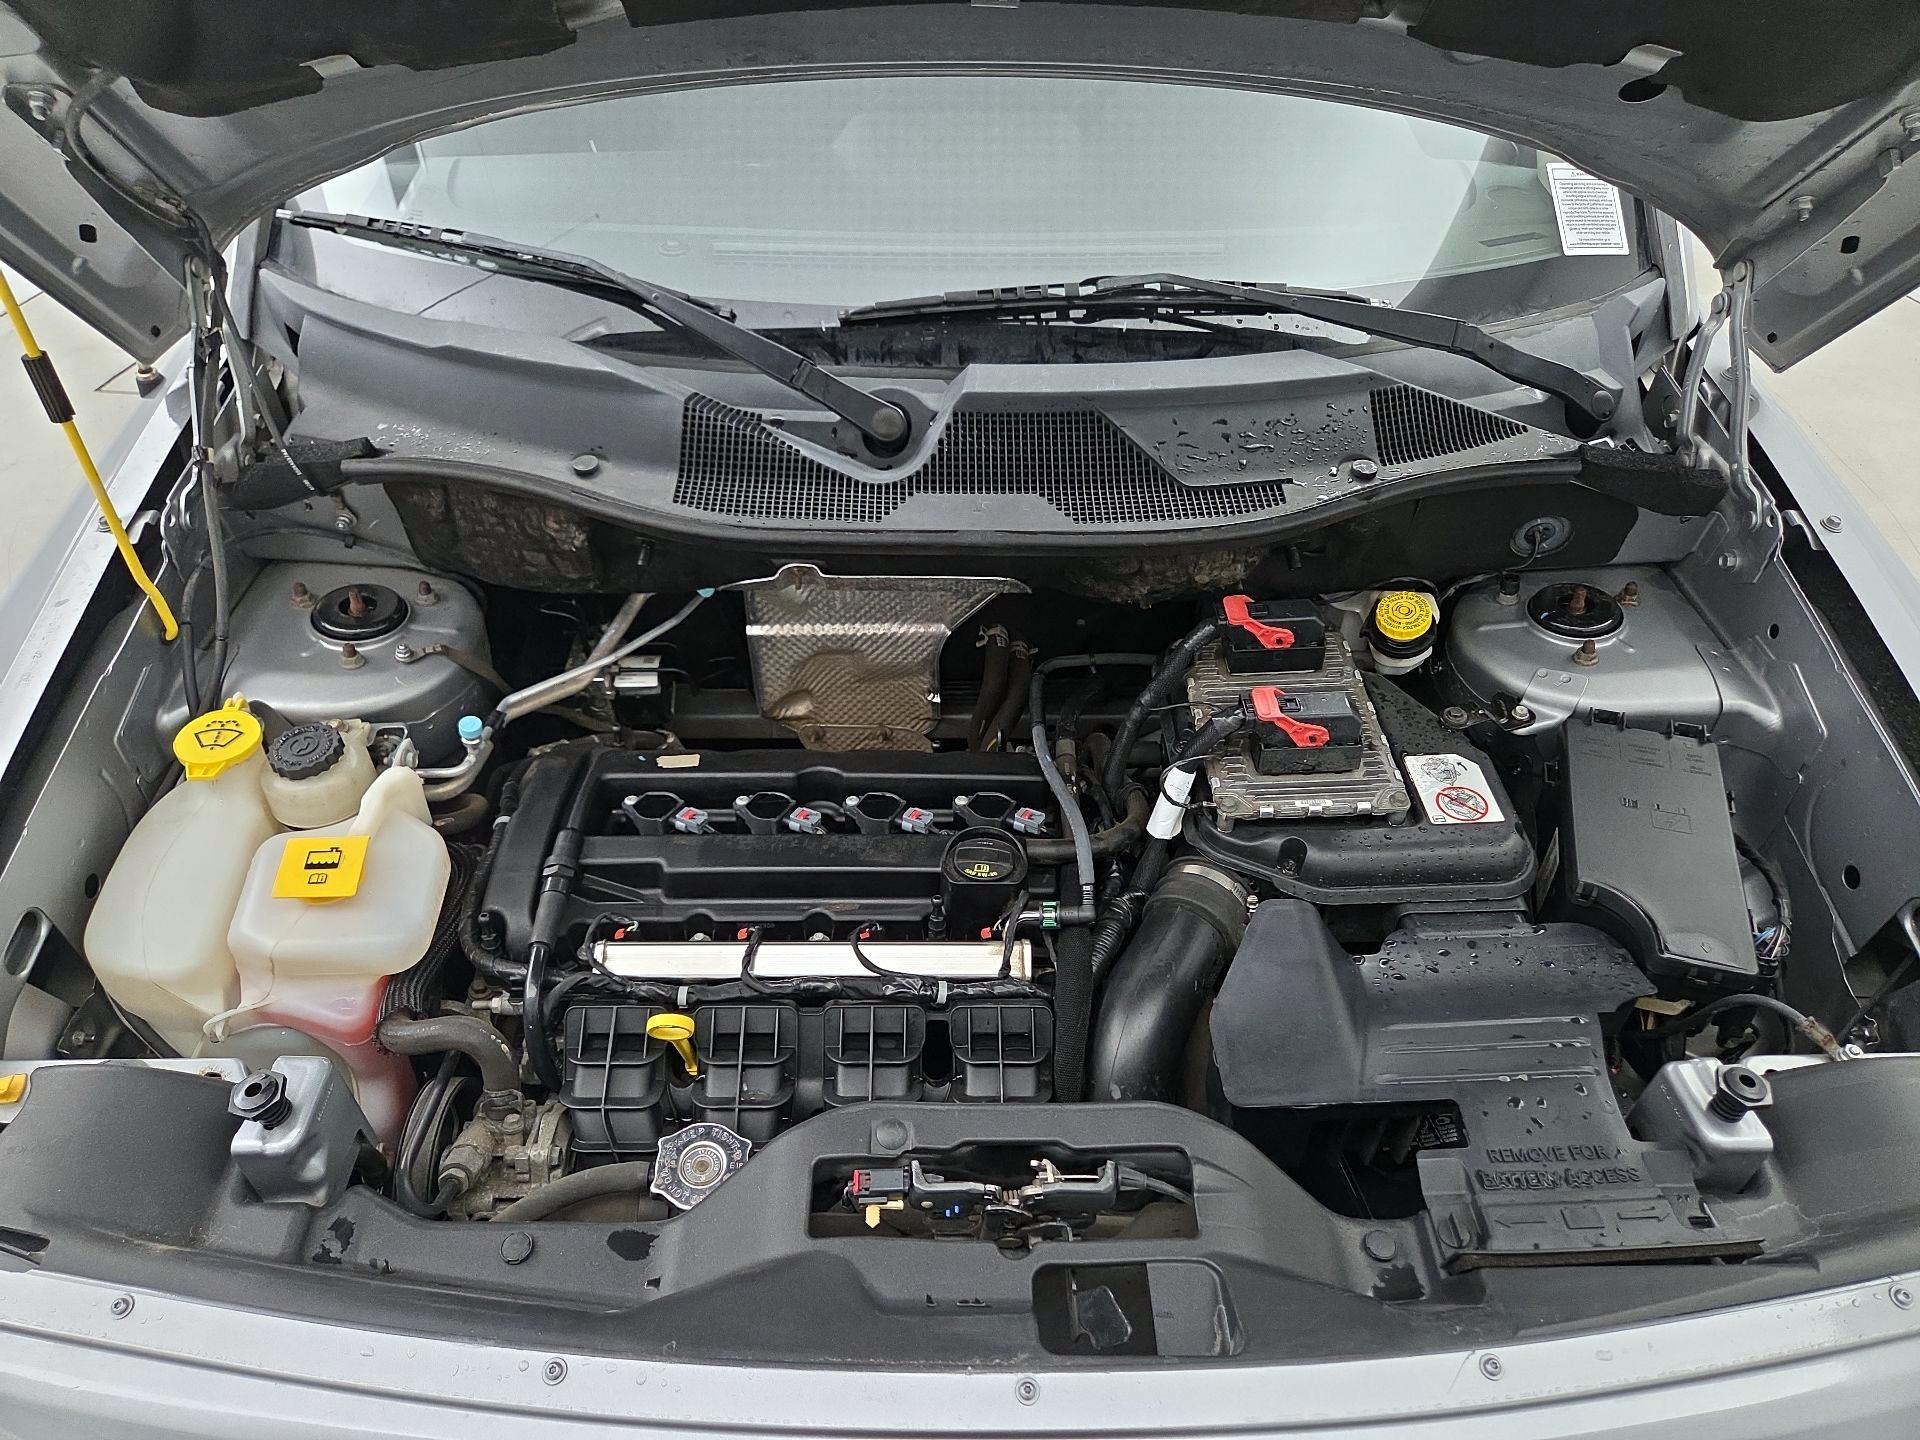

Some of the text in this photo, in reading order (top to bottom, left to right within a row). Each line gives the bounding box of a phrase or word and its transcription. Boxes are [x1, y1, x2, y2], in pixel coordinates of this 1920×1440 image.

[675, 1127, 740, 1150] KEEP TIGHT
[1486, 1144, 1610, 1163] REMOVE FOR
[1480, 1167, 1641, 1190] BATTERY ACCESS
